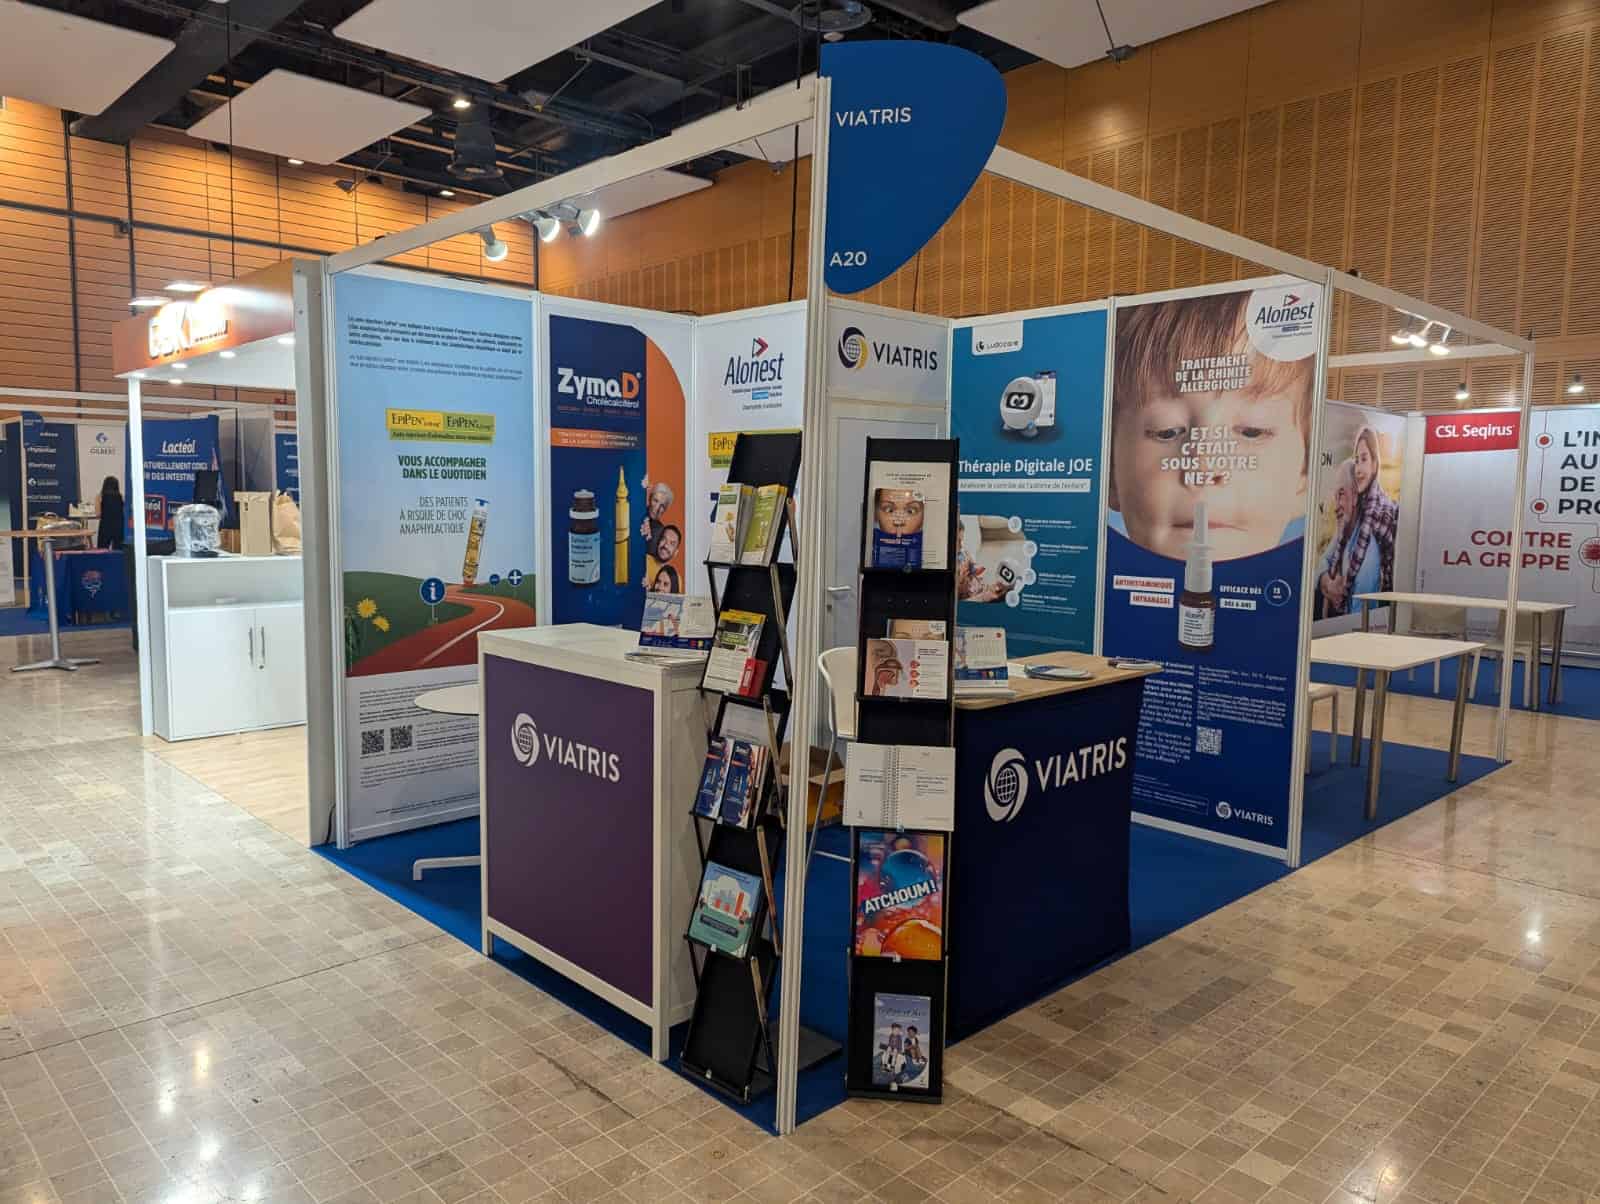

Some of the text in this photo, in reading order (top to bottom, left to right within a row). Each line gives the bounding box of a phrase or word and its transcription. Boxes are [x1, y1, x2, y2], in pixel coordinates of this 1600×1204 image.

[836, 107, 912, 127] VIATRIS
[829, 251, 867, 267] A20
[1254, 302, 1314, 325] Alonest
[873, 341, 938, 371] VIATRIS
[1181, 355, 1248, 370] TRAITEMENT
[724, 352, 784, 386] Alonest
[1175, 366, 1253, 382] DE LA RHINITE
[1180, 378, 1244, 393] ALLERGIQUE
[1190, 427, 1209, 441] ET
[1435, 424, 1513, 440] CSL Seqirus
[398, 455, 487, 468] VOUS ACCOMPAGNER
[959, 458, 1093, 476] Thérapie Digitale JOE
[1161, 455, 1257, 470] SOUS VOTRE
[1560, 453, 1598, 470] AU
[402, 468, 487, 481] DANS LE QUOTIDIEN
[1184, 471, 1215, 485] NEZ
[1560, 476, 1596, 492] DE
[419, 496, 468, 507] DES PATIENTS
[407, 510, 435, 521] RISQUE
[436, 509, 446, 520] DE
[447, 509, 467, 521] CHOC
[400, 522, 465, 535] ANAPHYLACTIQUE
[1443, 550, 1570, 570] LA GRPPE
[543, 733, 620, 782] VIATRIS
[1035, 736, 1127, 792] VIATRIS
[1233, 808, 1274, 826] VIATRIS
